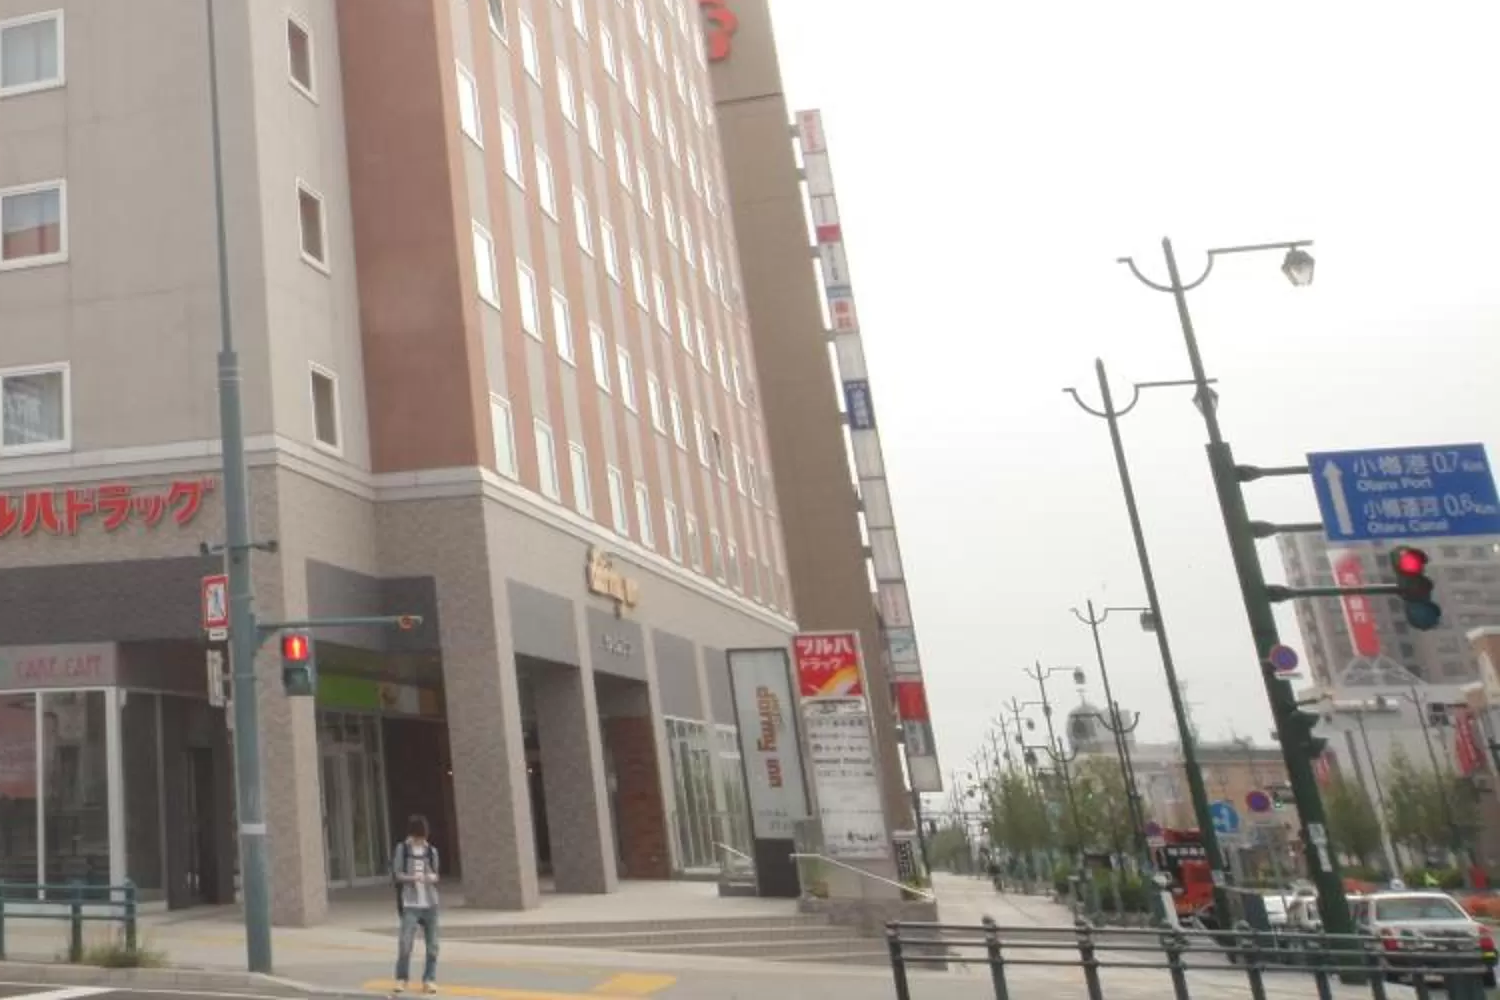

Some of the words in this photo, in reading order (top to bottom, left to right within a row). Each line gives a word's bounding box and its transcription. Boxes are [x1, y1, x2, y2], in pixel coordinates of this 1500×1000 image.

[1352, 454, 1430, 477] 小樽港
[1400, 476, 1433, 489] Port
[796, 637, 853, 656] ツルハ
